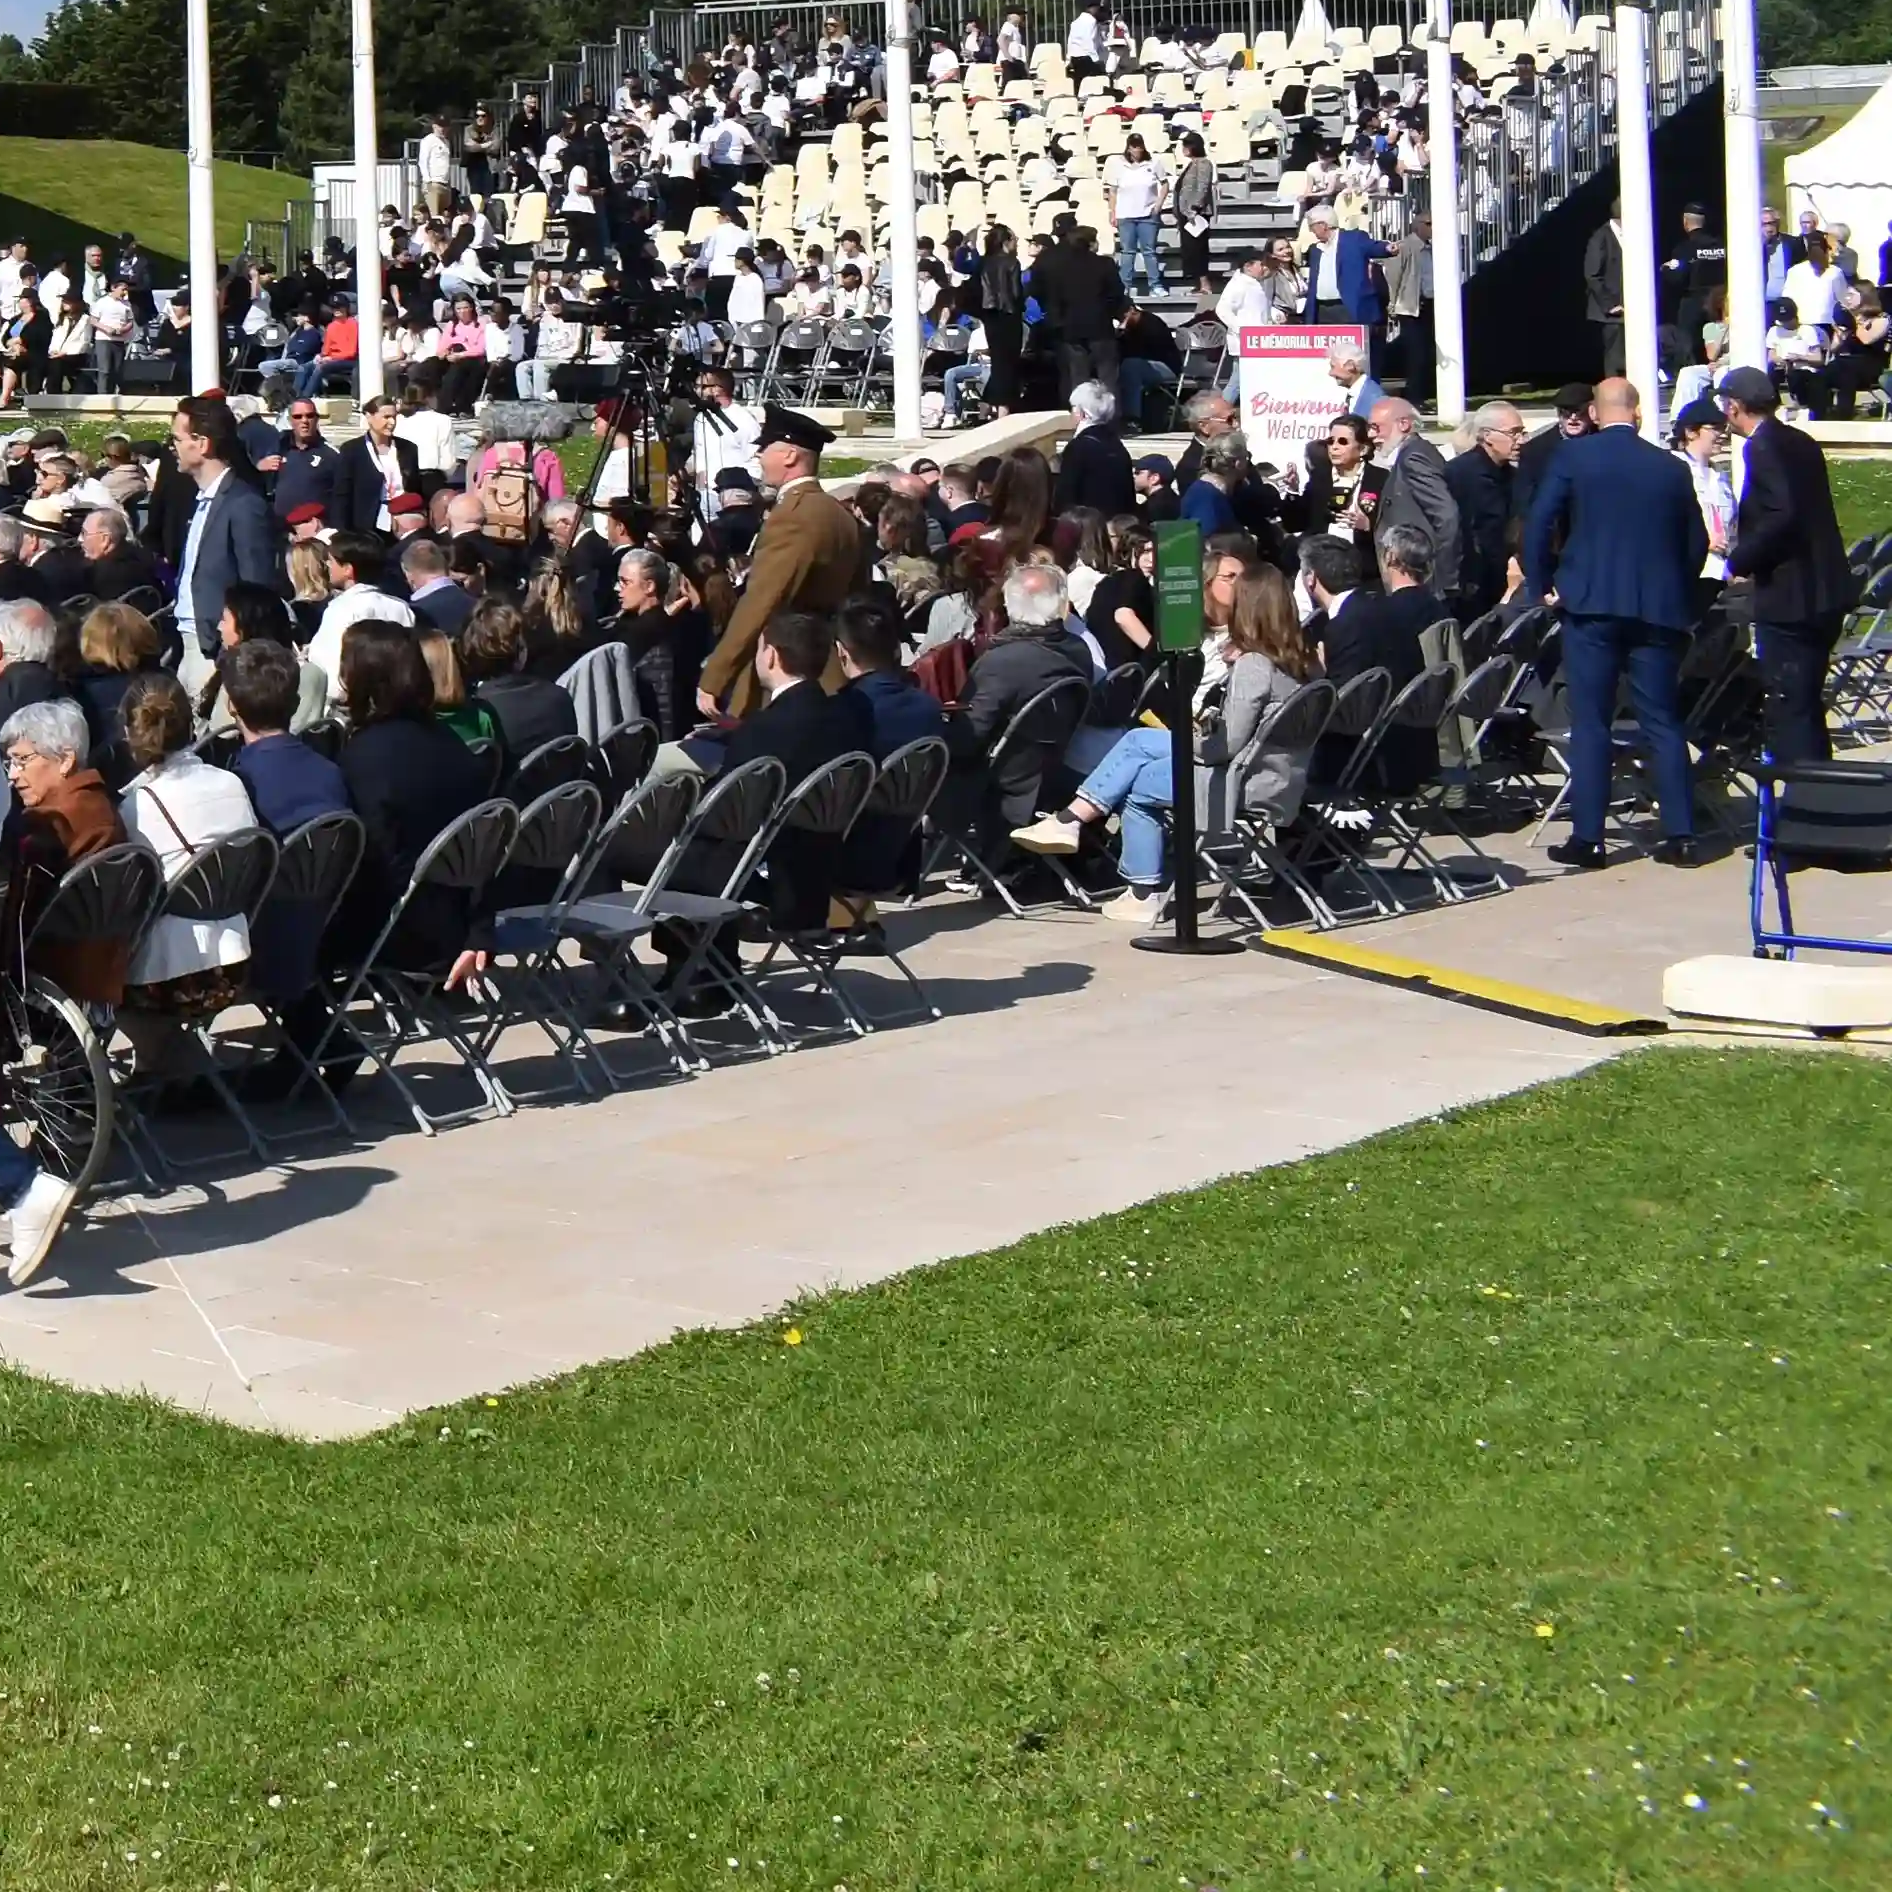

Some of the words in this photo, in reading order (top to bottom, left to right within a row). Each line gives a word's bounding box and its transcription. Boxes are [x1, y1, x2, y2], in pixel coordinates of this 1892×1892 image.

[1696, 248, 1725, 256] POLICE
[1246, 335, 1259, 349] LE
[1260, 333, 1313, 349] MÉMORIAL
[1314, 335, 1328, 349] DE
[1251, 391, 1347, 417] Bienvenu
[1267, 419, 1330, 440] Welcom
